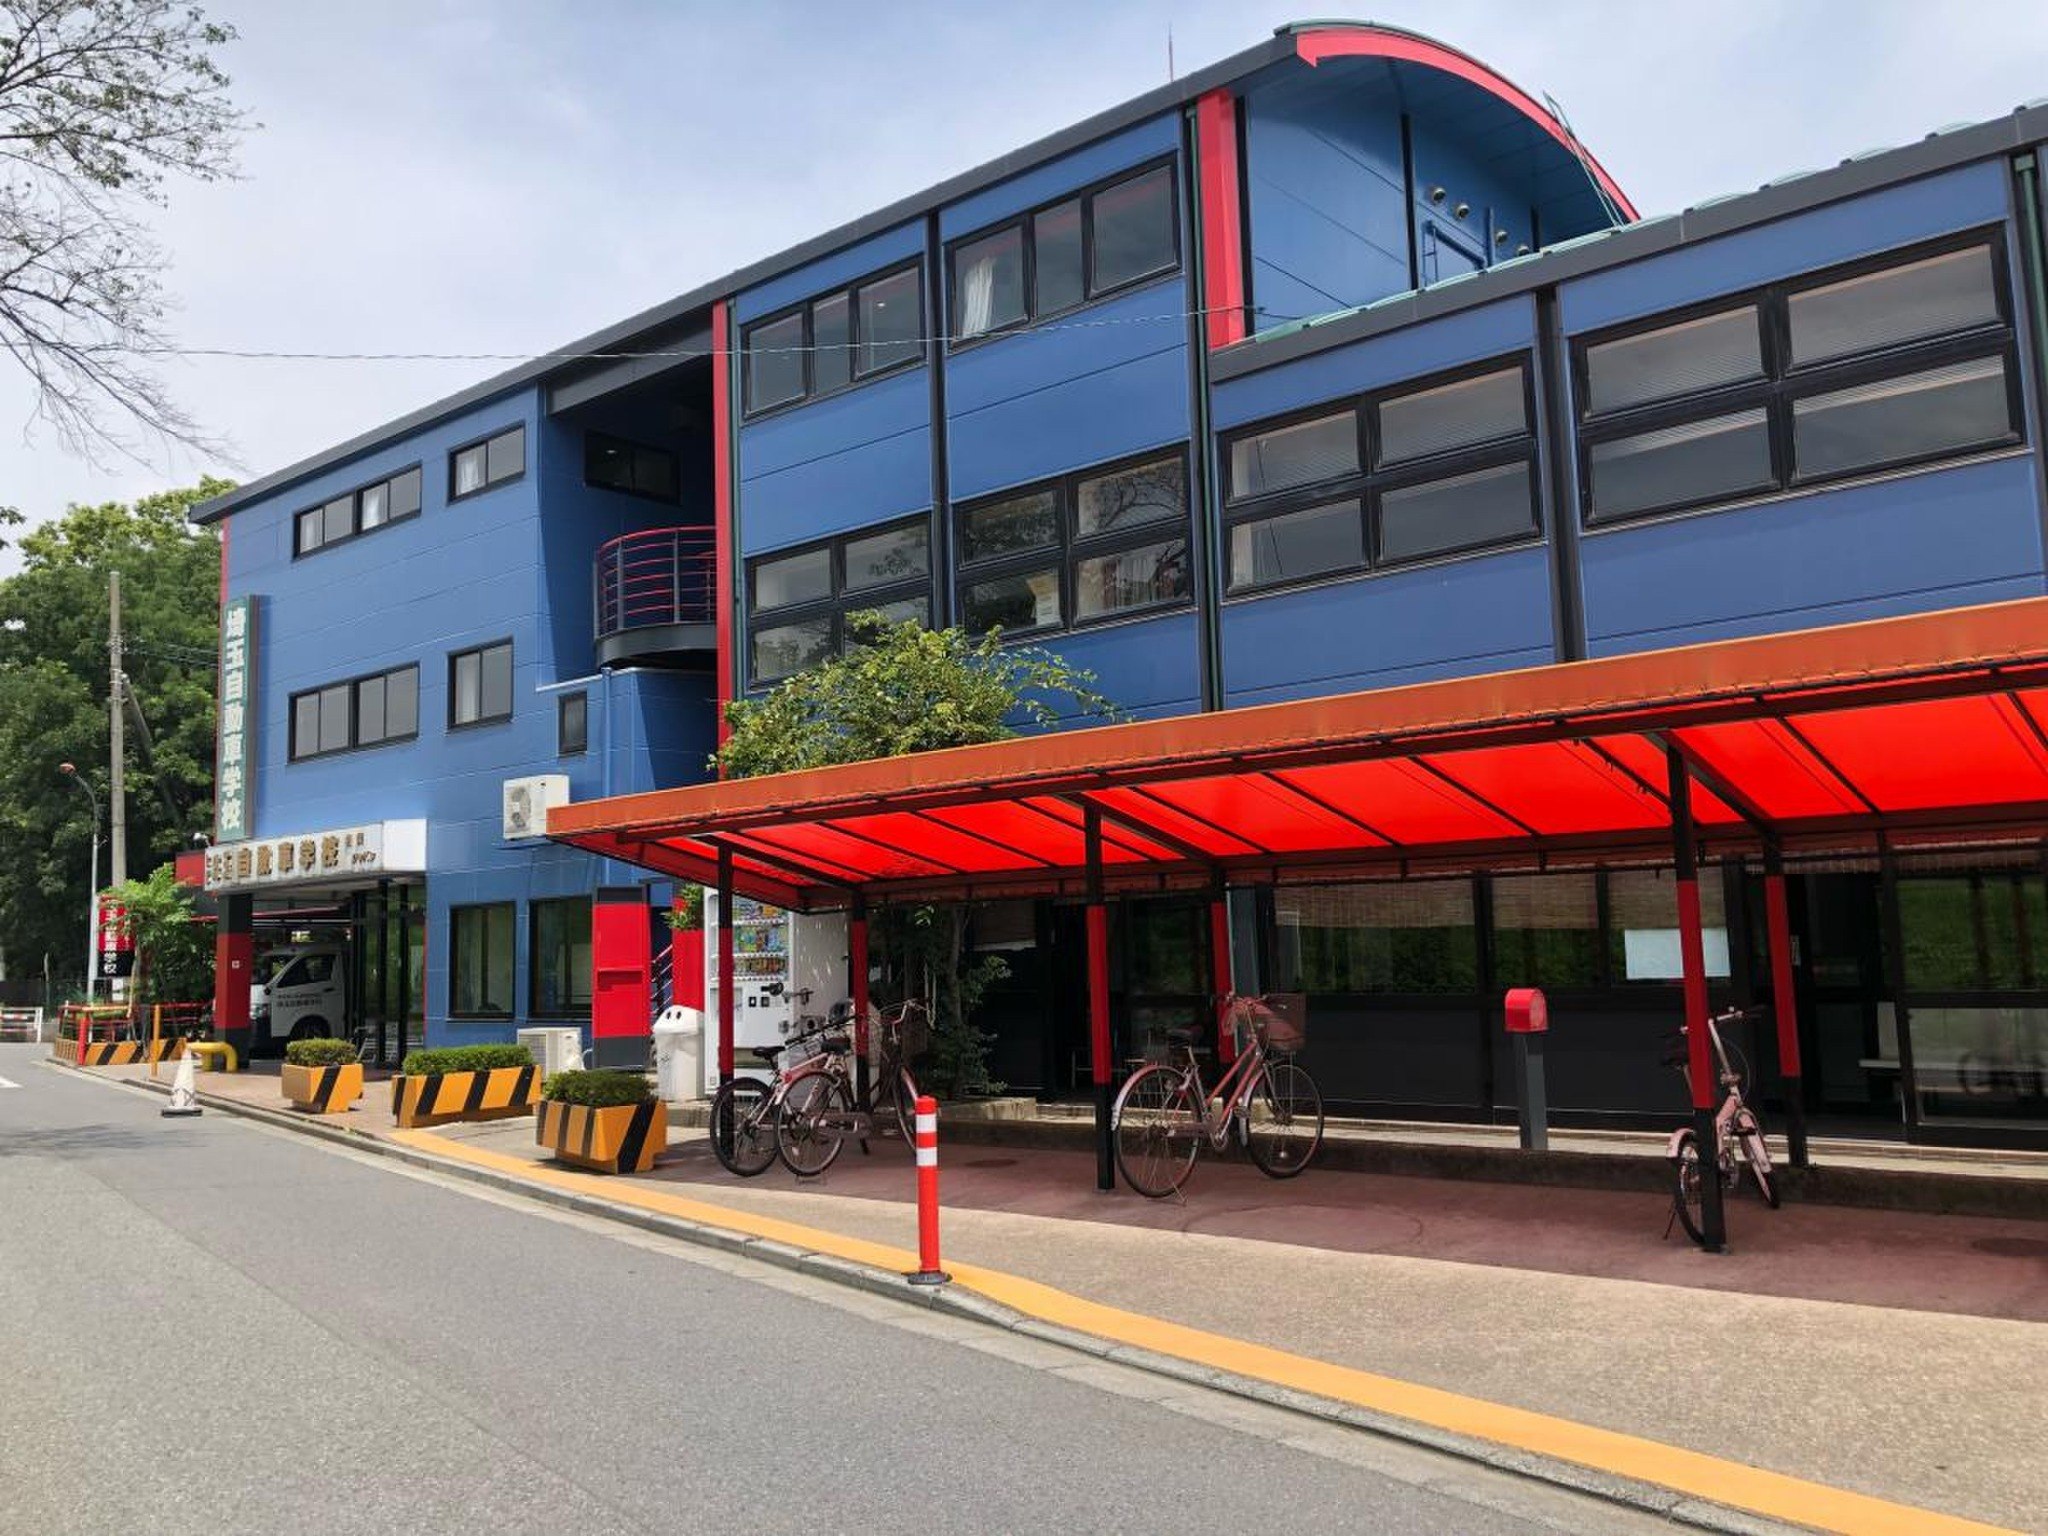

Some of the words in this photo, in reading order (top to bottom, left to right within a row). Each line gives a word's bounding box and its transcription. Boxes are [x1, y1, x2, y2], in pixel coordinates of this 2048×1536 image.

[221, 607, 247, 830] 埼玉自動車学校
